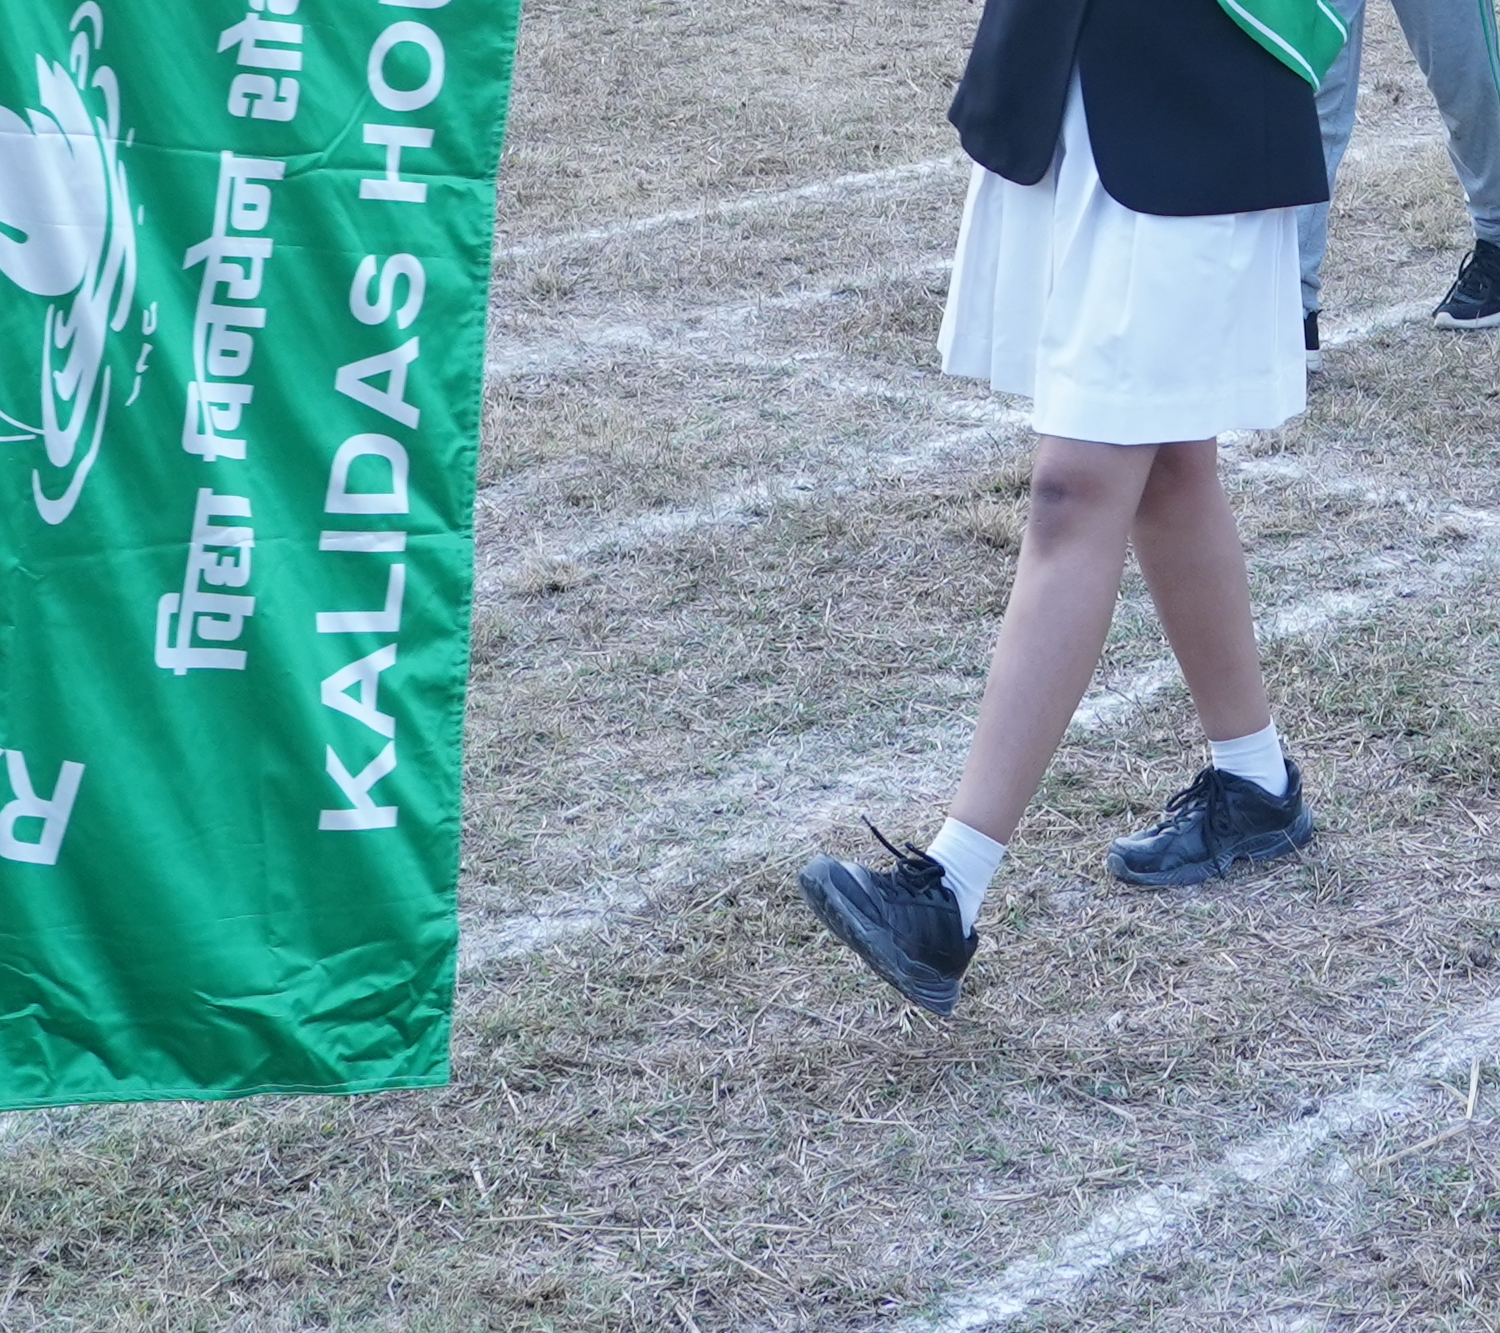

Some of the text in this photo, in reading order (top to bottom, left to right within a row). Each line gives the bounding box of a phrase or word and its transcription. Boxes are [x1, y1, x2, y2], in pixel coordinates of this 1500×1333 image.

[183, 151, 285, 461] विनयेन
[155, 488, 255, 675] विद्या
[316, 254, 425, 831] KALIDAS
